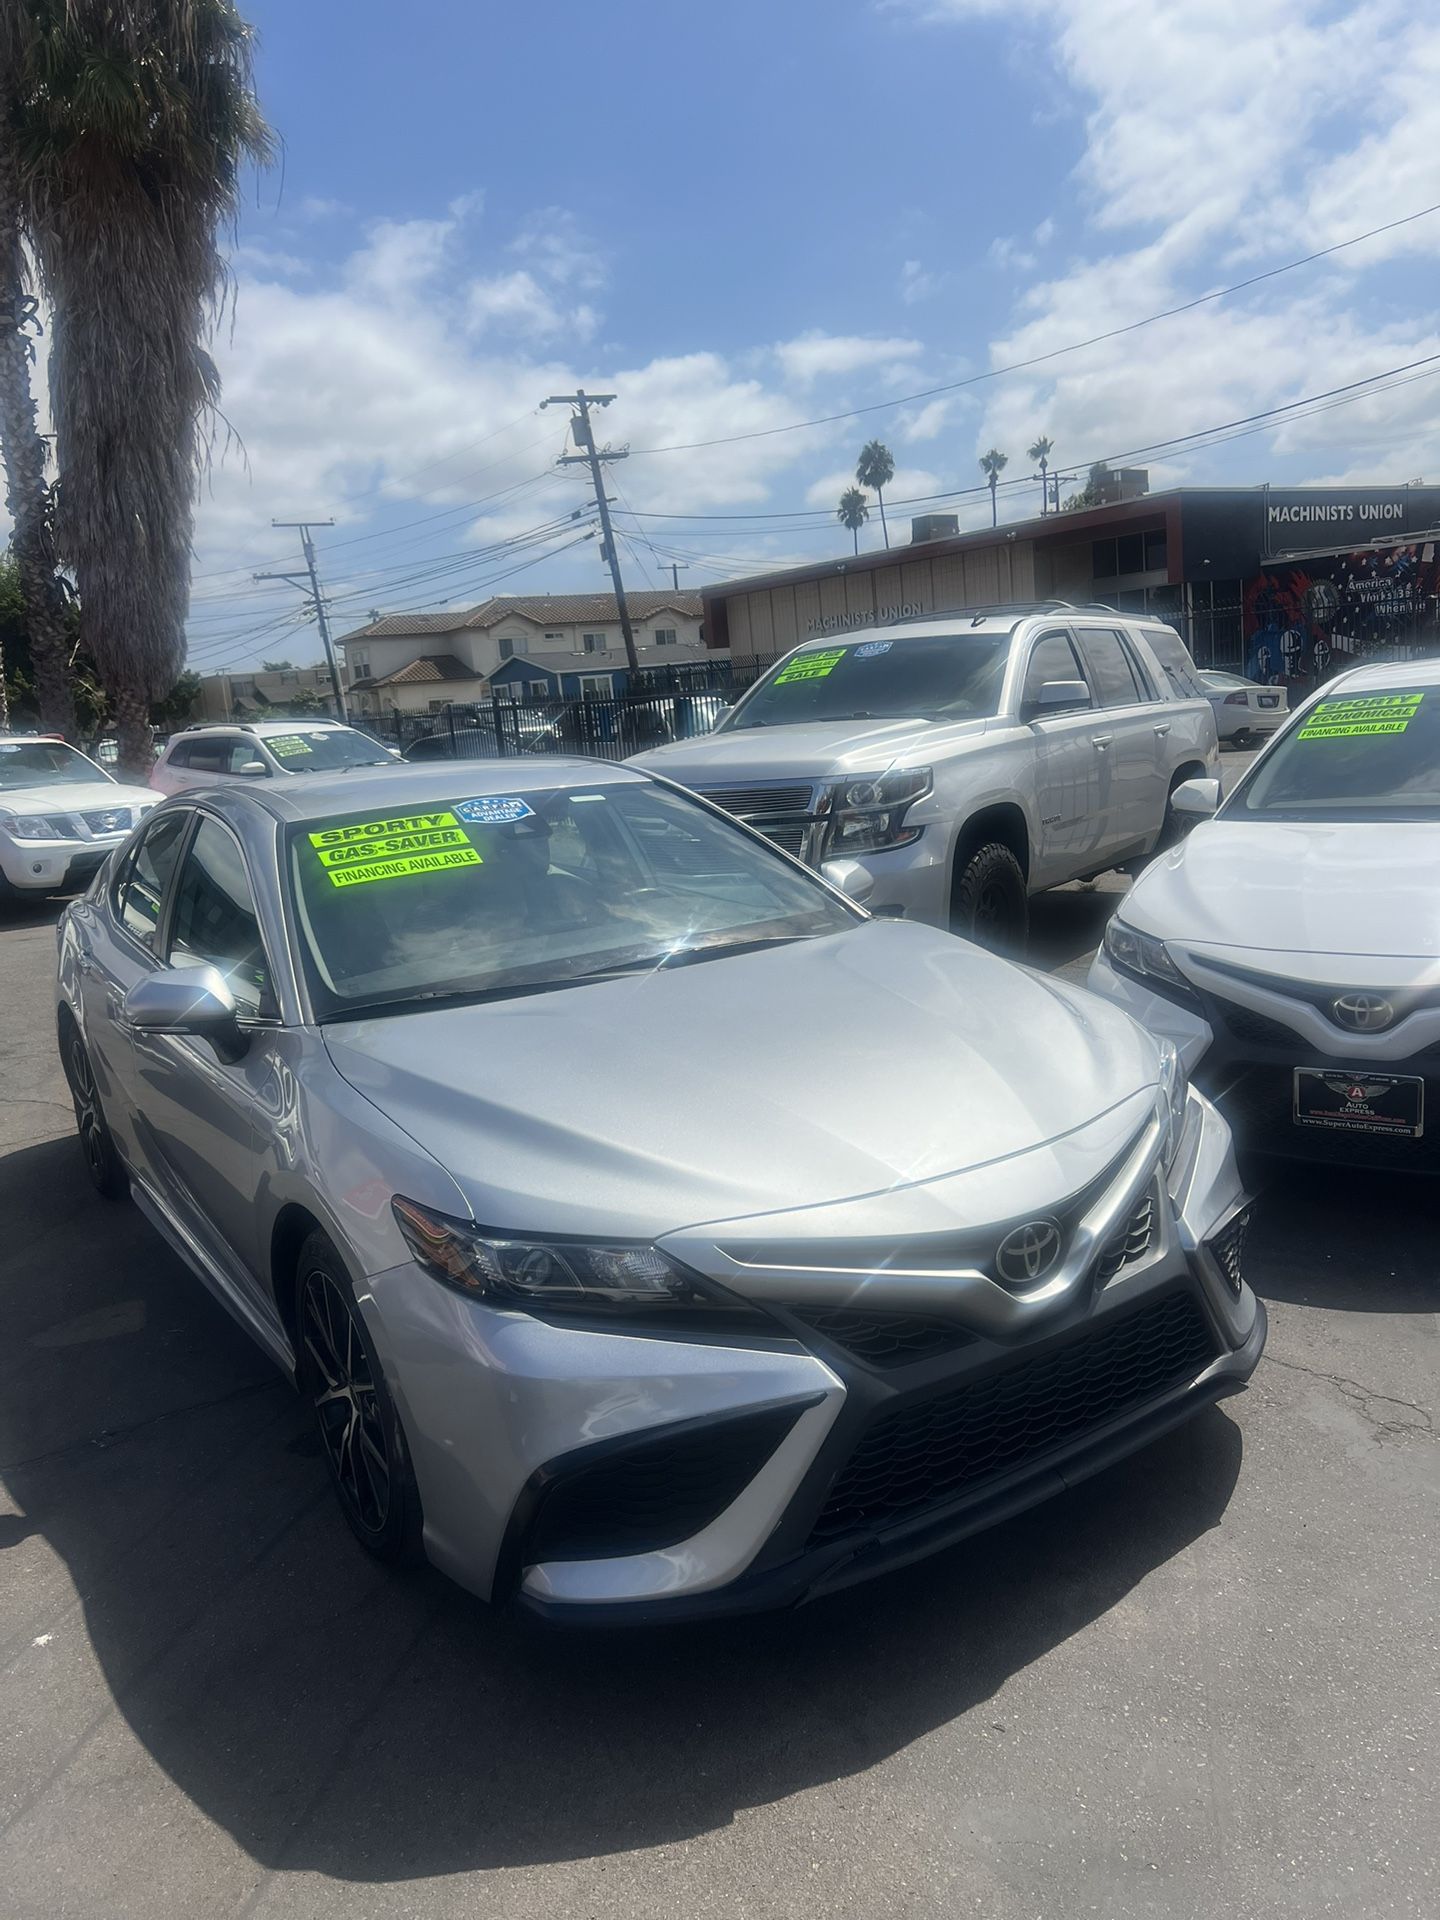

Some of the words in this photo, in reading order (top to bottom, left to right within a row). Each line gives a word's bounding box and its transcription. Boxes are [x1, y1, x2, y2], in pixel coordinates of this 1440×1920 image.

[1269, 505, 1354, 522] MACHINISTS
[1359, 504, 1403, 520] UNION
[1348, 578, 1391, 590] America
[807, 609, 875, 632] MACHINISTS
[880, 602, 923, 620] UNION
[1322, 696, 1416, 711] SPORTY
[1312, 707, 1413, 723] ECONOMICAL
[1301, 726, 1350, 737] FINANCING
[1352, 722, 1404, 733] AVAILABLE
[471, 808, 522, 818] ADVANTAGE
[483, 813, 518, 822] DEALER
[321, 815, 445, 844] SPORTY
[329, 831, 460, 862] GAS-SAVER
[334, 861, 407, 884] FINANCING
[409, 851, 477, 872] AVAILABLE
[1351, 1087, 1363, 1097] A
[1339, 1107, 1375, 1116] EXPRESS
[1345, 1101, 1369, 1110] AUTO
[1302, 1118, 1411, 1135] www.SuperAutoExpress.com
